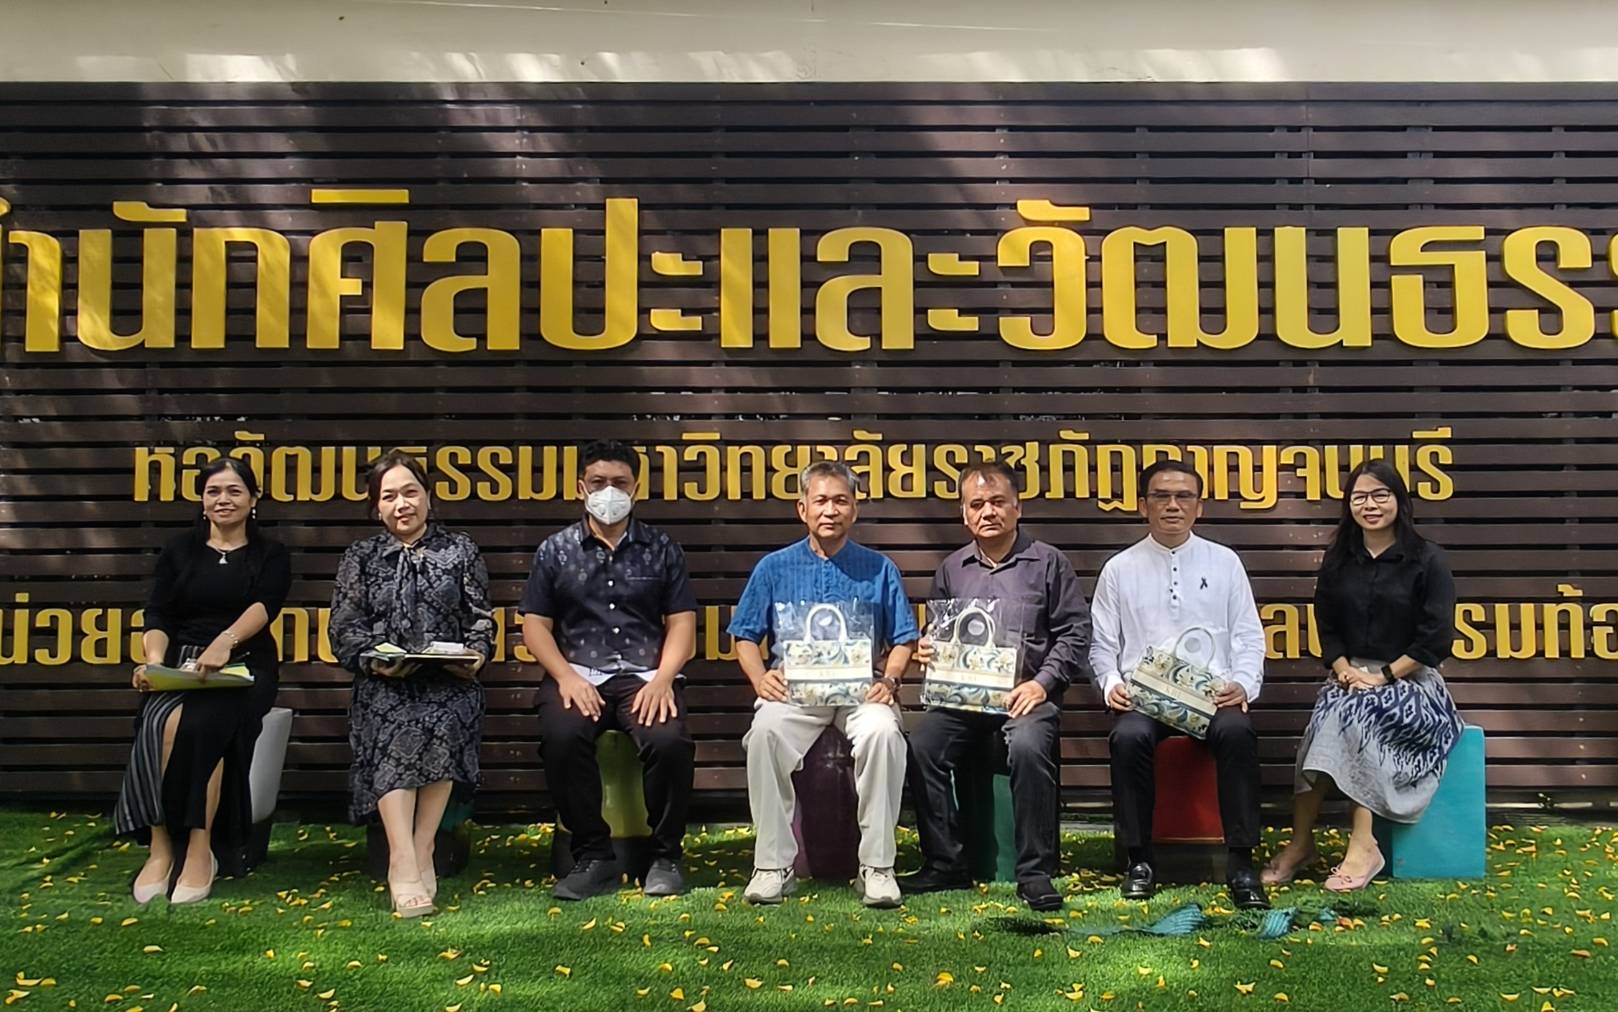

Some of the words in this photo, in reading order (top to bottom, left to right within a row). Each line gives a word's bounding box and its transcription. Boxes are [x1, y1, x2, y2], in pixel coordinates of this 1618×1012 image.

[0, 188, 1618, 352] ำนักศิลปะและวัฒนธร
